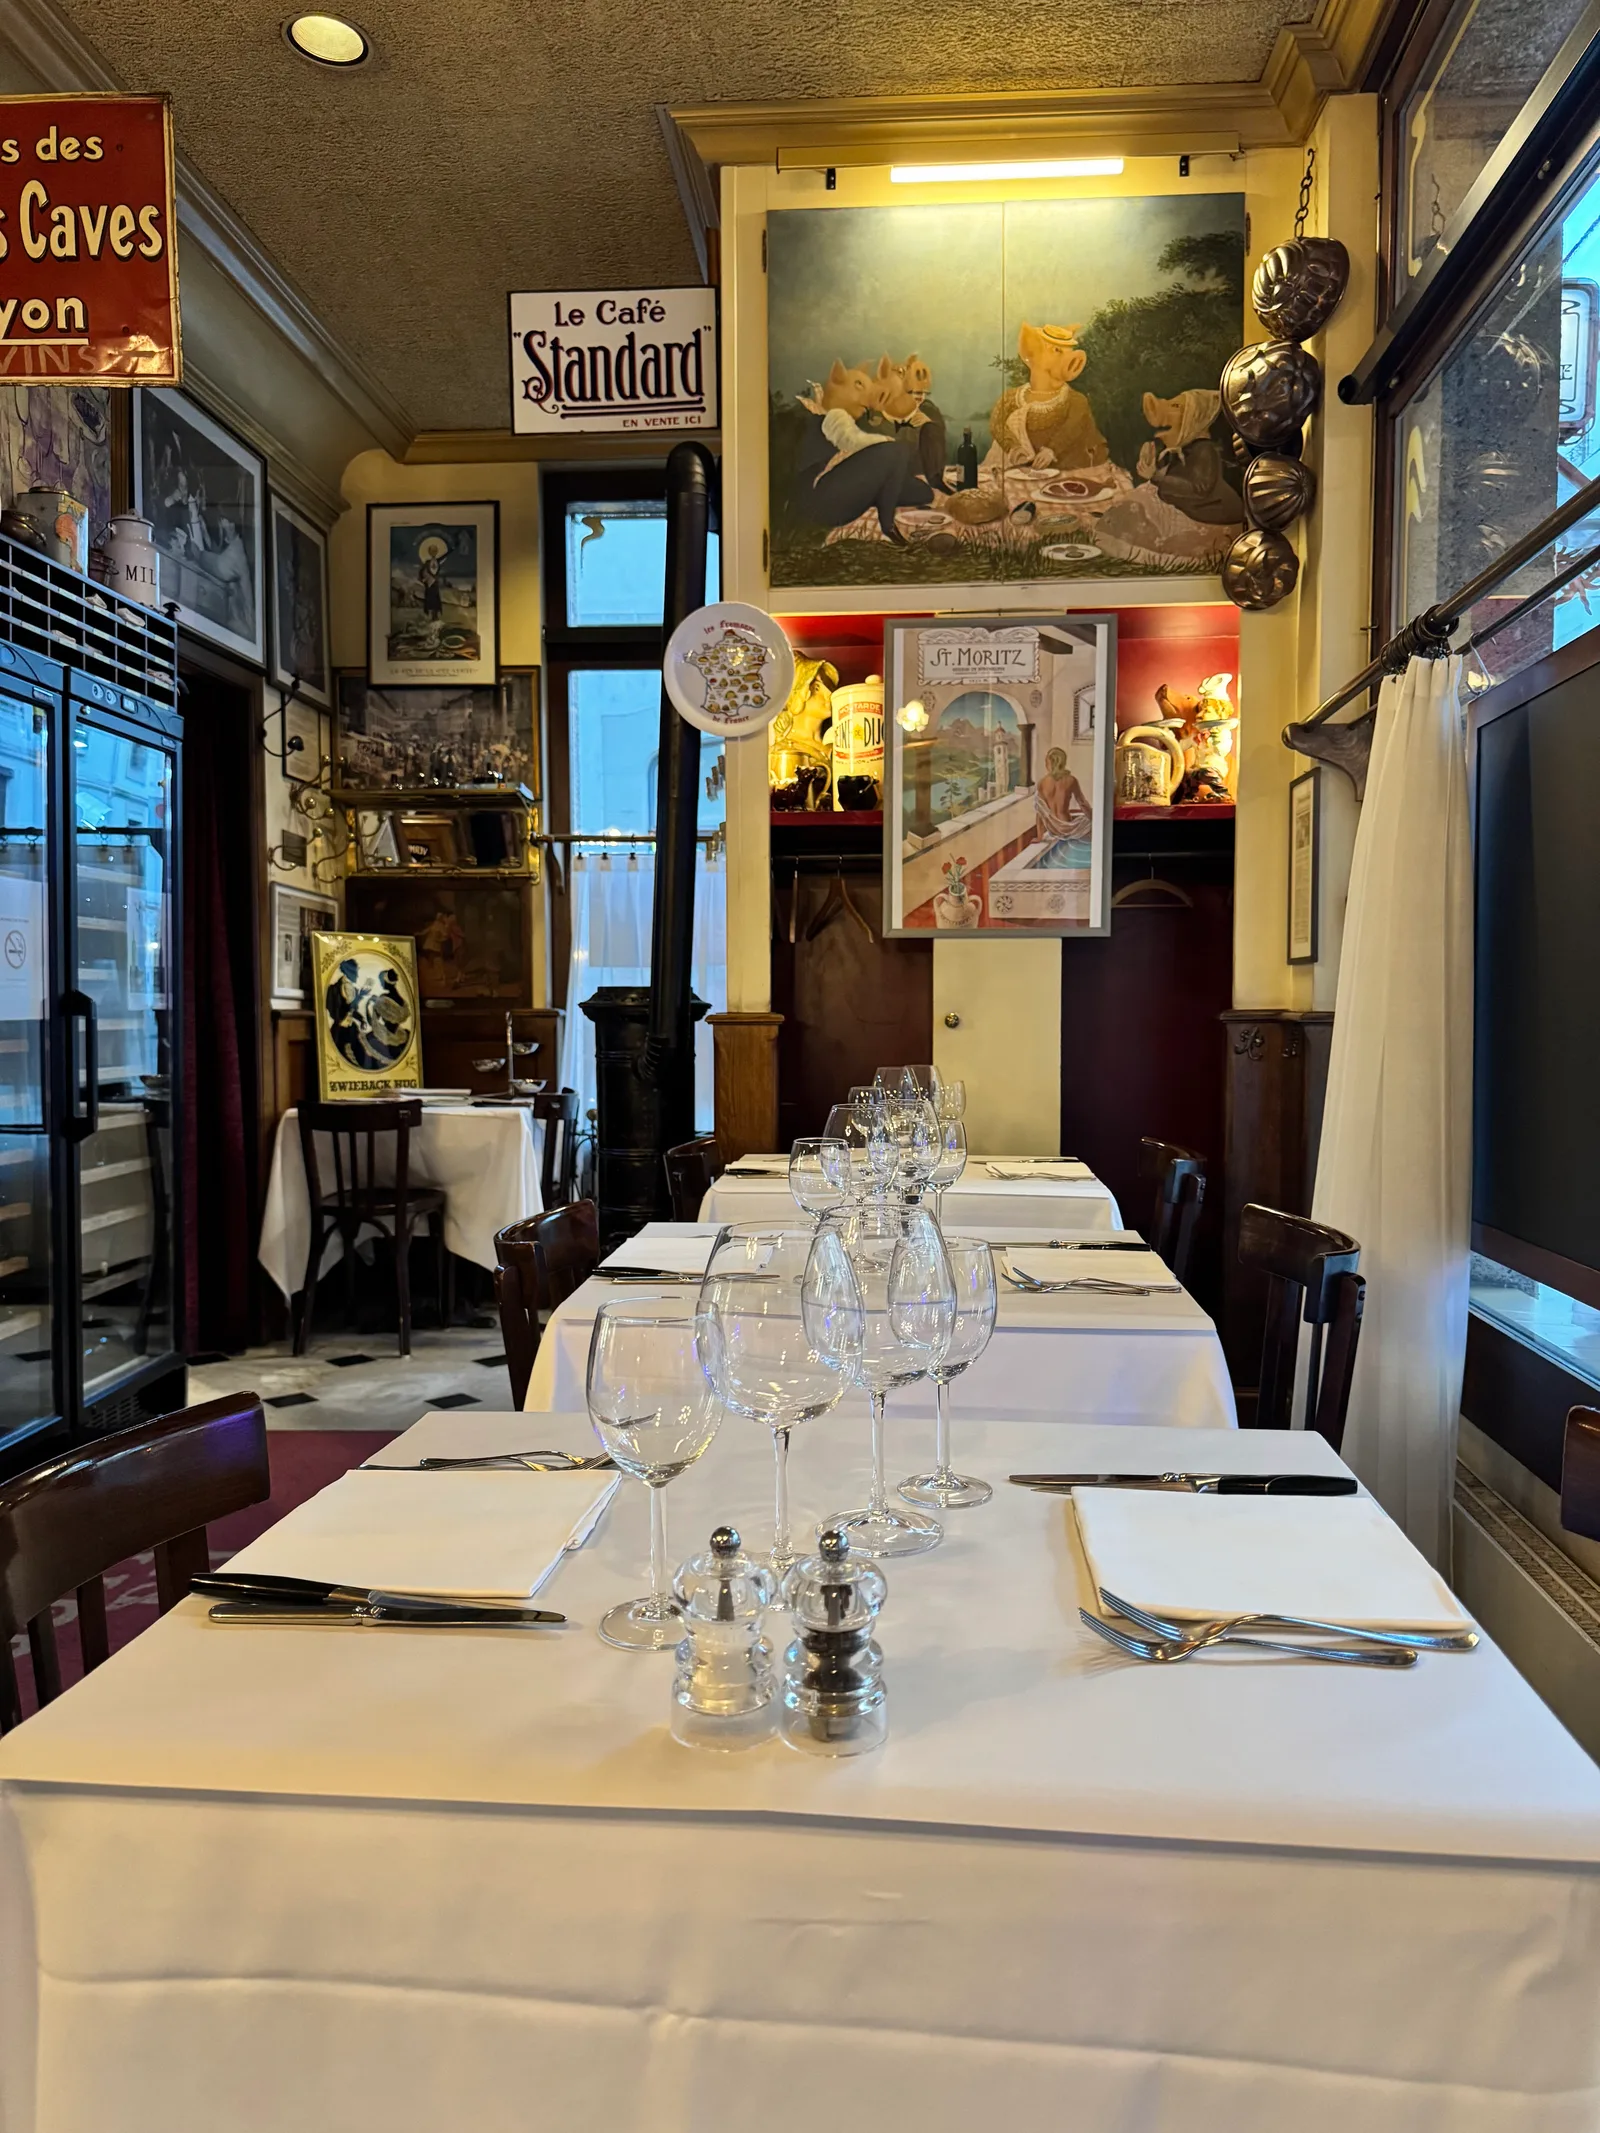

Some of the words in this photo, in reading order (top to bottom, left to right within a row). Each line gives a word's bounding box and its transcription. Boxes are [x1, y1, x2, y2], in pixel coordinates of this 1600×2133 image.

[35, 126, 104, 161] des
[19, 179, 163, 259] Caves
[0, 296, 85, 338] yon
[554, 301, 585, 327] Le
[596, 298, 666, 325] Café
[622, 419, 639, 428] EN
[644, 417, 680, 427] VENTE
[685, 415, 702, 425] ICI
[125, 564, 157, 586] MIL
[839, 702, 882, 715] MOTARDE
[864, 717, 884, 747] DIJ
[329, 1079, 392, 1092] ZWIEBACK
